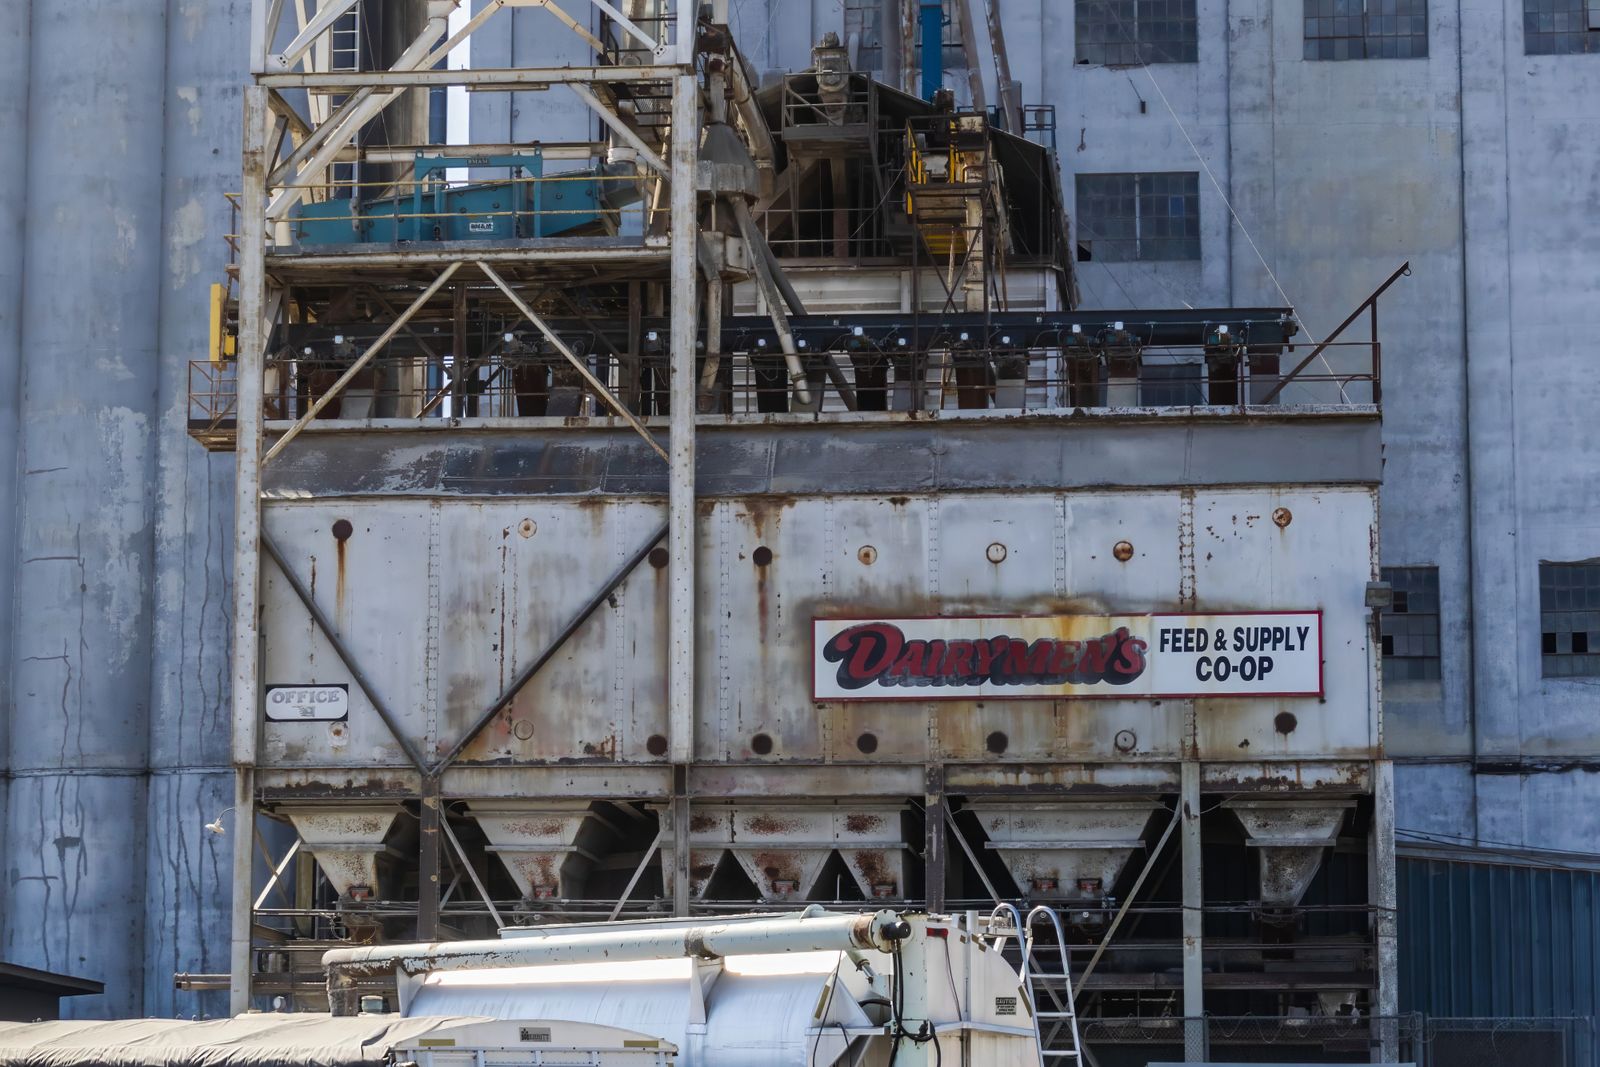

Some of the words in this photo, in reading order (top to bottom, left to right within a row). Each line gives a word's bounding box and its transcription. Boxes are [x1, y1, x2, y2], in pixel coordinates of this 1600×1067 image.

[1159, 628, 1209, 652] FEED
[1213, 628, 1228, 651] &
[1232, 626, 1310, 652] SUPPLY
[823, 622, 1148, 690] DAIRYMEN'S
[1195, 655, 1274, 682] CO-OP
[271, 690, 340, 704] OFFICE
